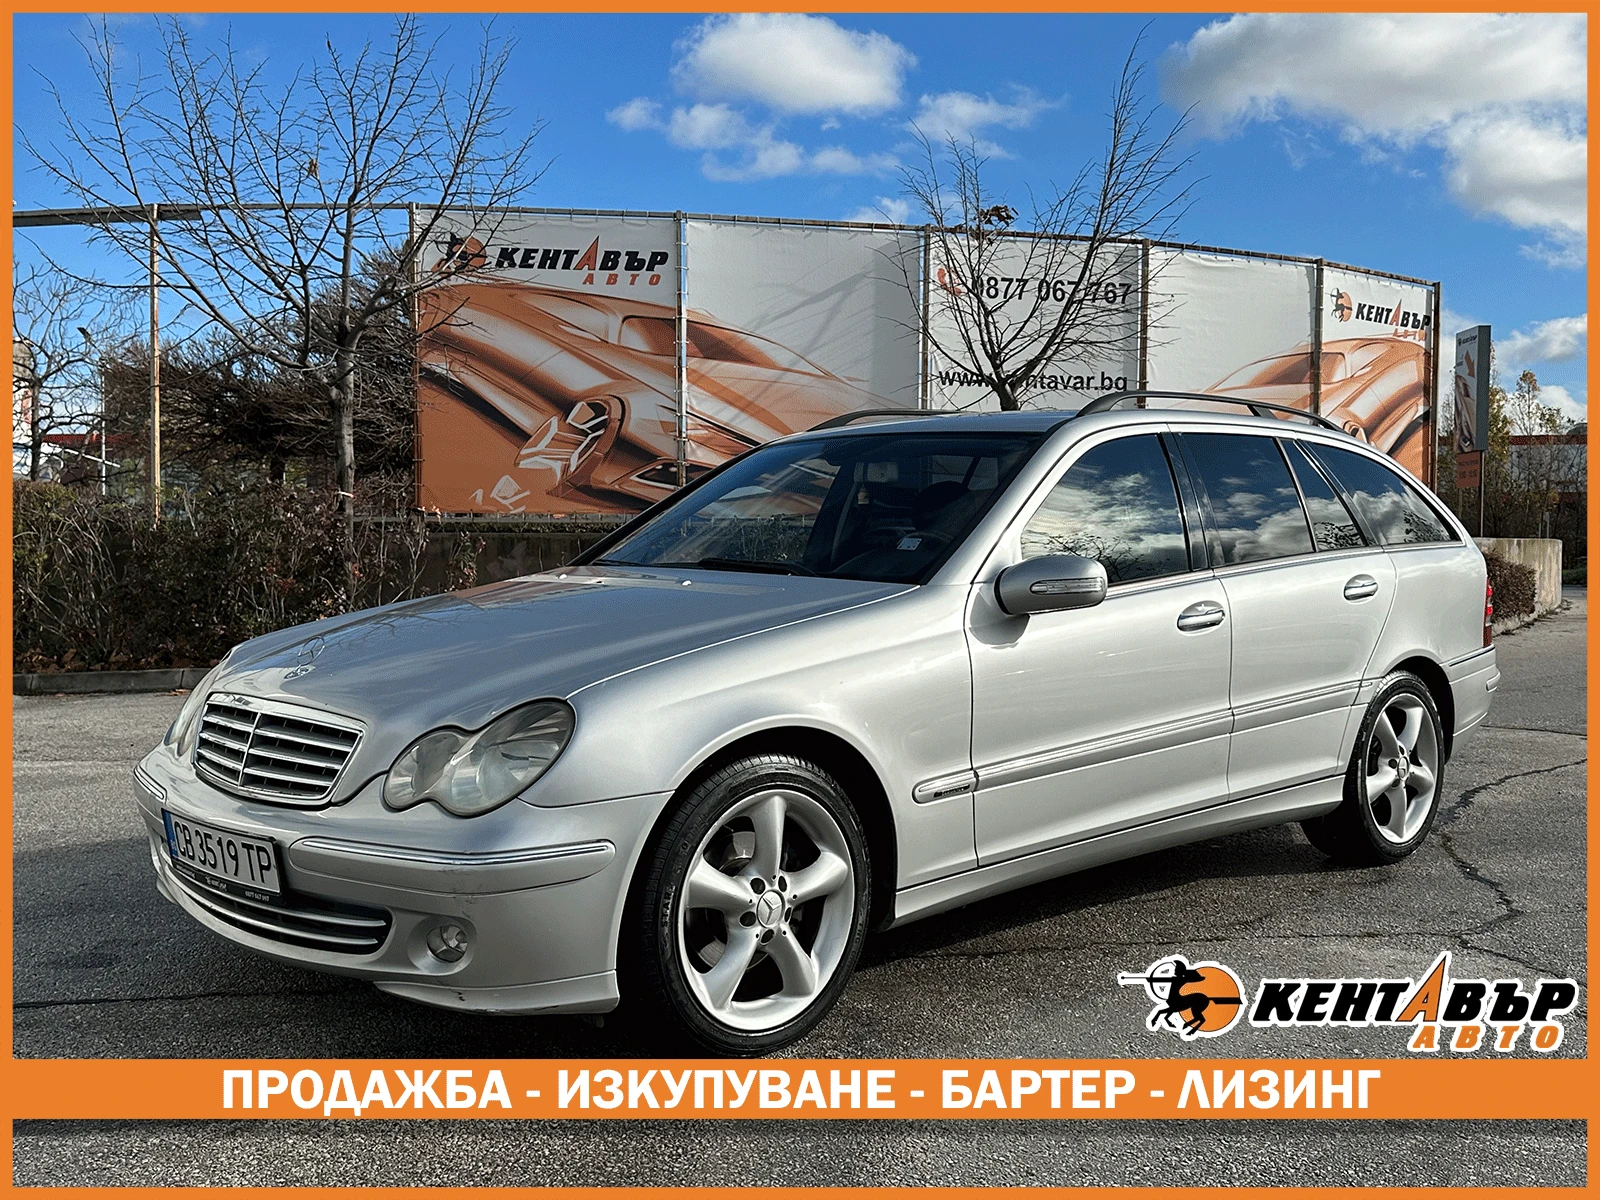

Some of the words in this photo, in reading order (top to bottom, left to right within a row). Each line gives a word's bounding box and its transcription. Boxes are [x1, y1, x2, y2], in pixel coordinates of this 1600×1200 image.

[495, 235, 669, 272] КЕНТАВЪР
[582, 273, 662, 286] АВТО
[971, 276, 1029, 300] 0877
[1355, 298, 1431, 331] КЕНТАВЪР
[938, 370, 1128, 391] wwwntavar.bg
[195, 829, 239, 877] 3519
